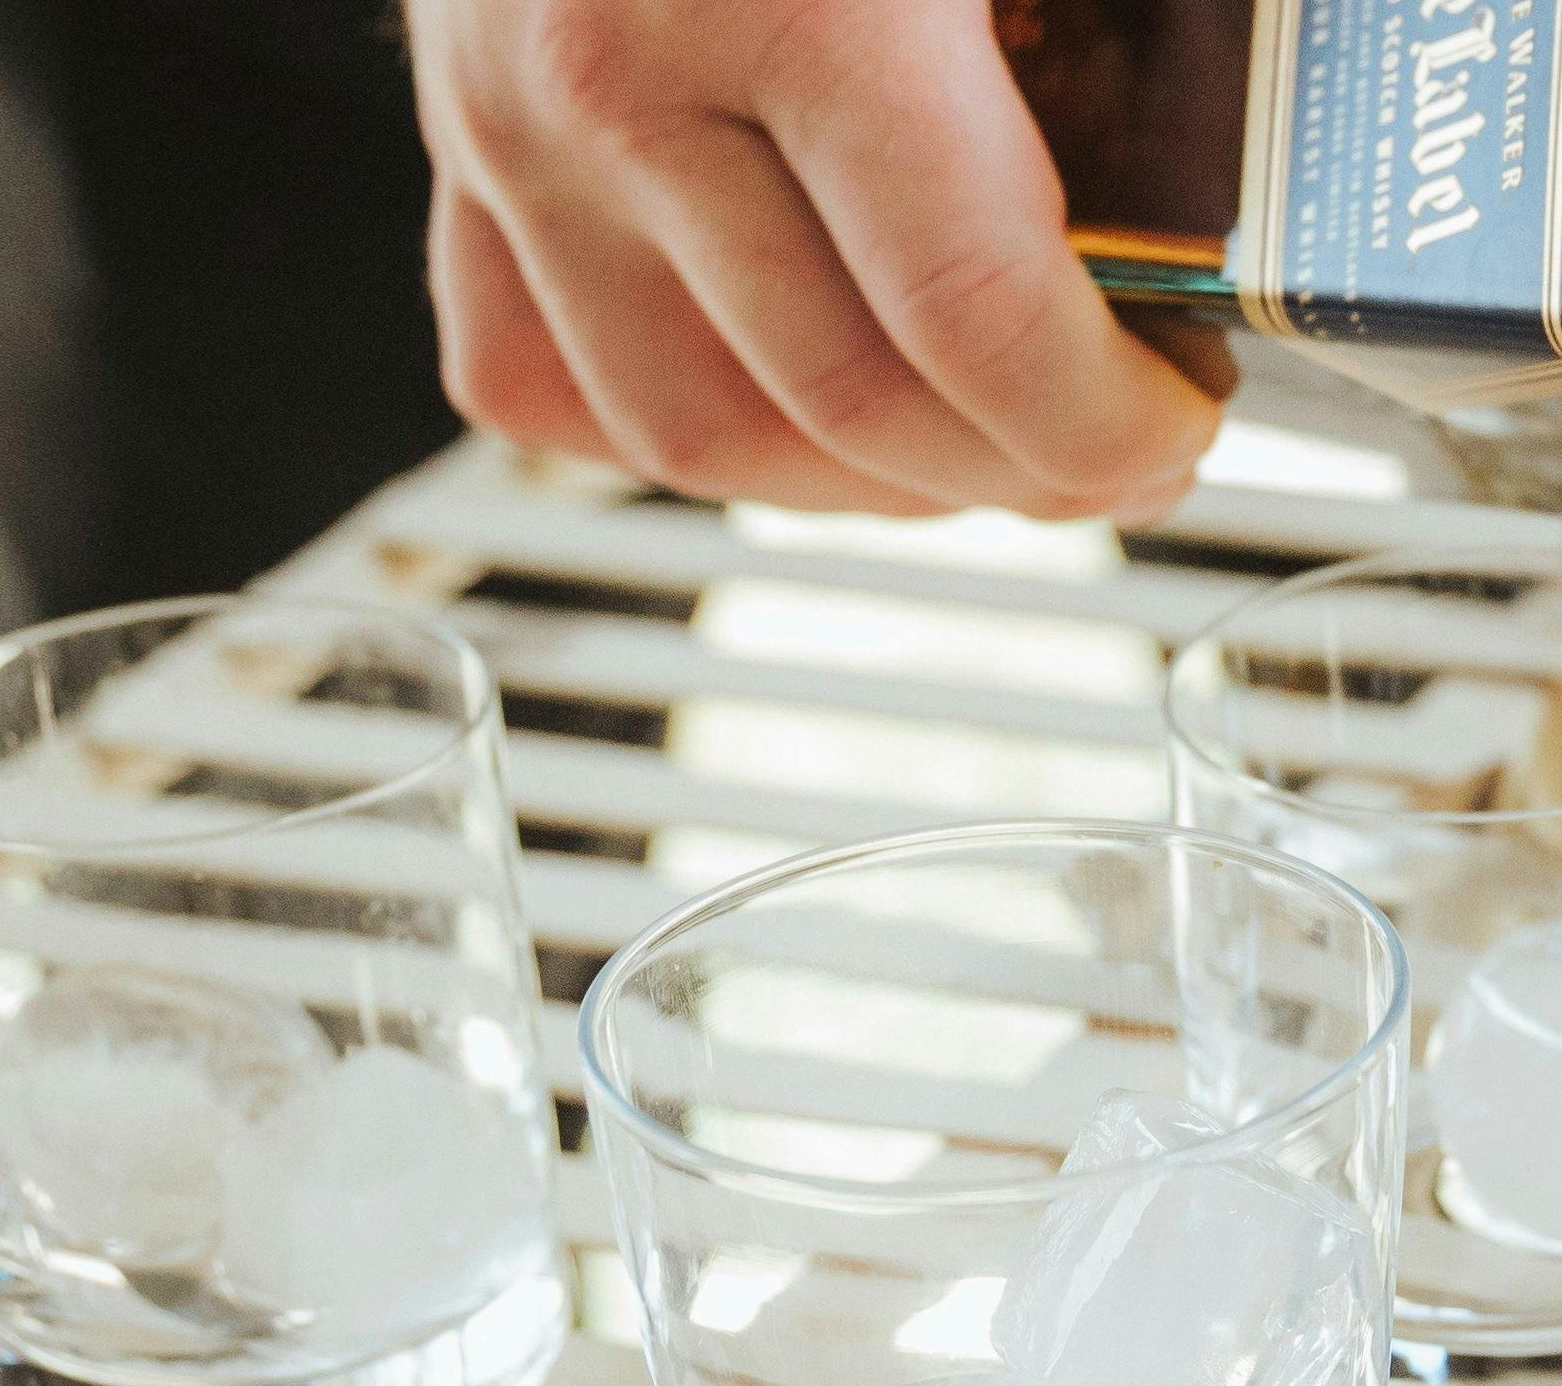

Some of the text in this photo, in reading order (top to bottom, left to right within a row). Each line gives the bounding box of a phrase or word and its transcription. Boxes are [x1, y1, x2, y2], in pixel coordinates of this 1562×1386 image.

[1379, 14, 1403, 126] SCOTCH
[1406, 7, 1498, 253] Label
[1502, 28, 1535, 190] WALKER
[1372, 136, 1394, 250] WHISKY
